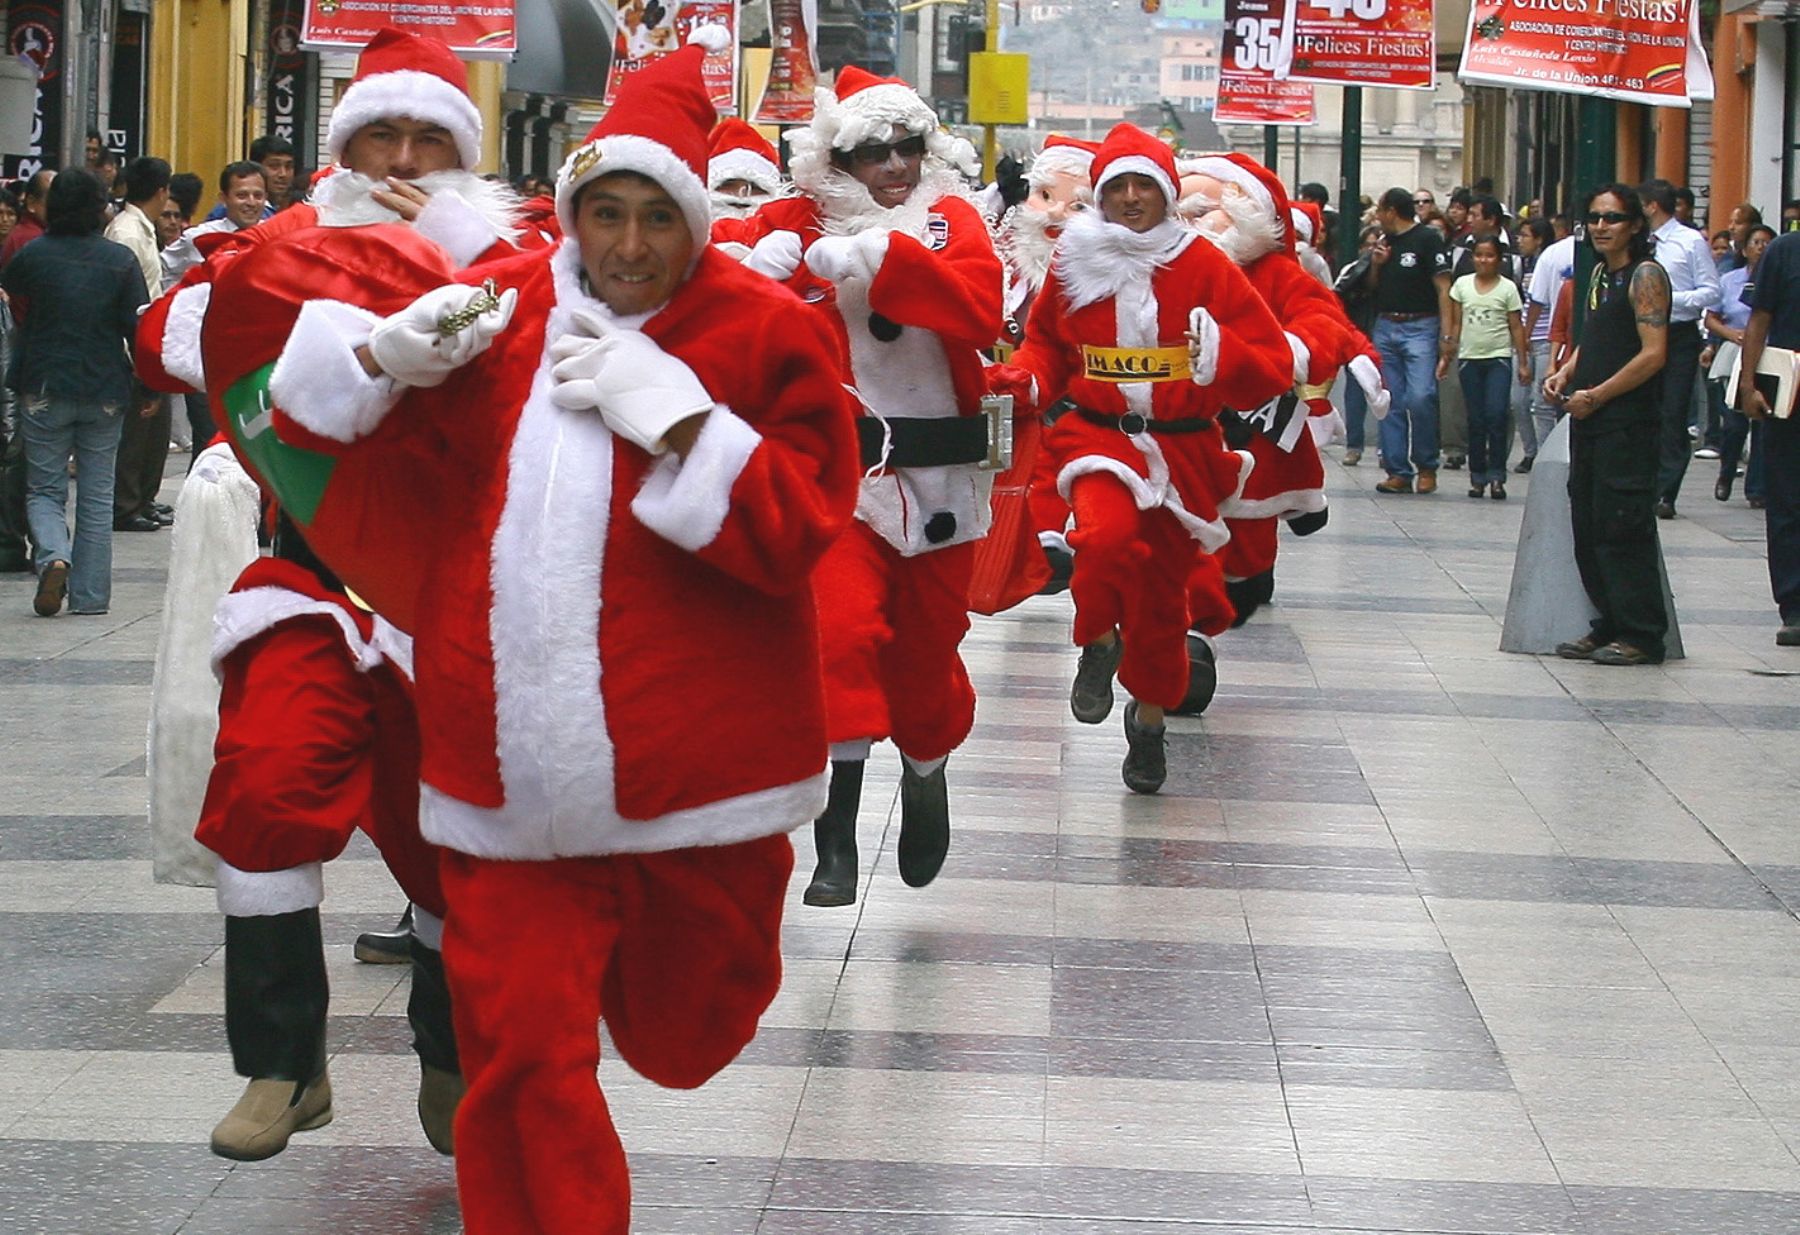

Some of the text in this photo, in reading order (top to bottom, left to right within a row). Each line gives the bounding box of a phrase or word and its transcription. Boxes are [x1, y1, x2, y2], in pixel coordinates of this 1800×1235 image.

[1235, 17, 1280, 71] 35
[1366, 37, 1430, 58] Fiestas!
[1471, 43, 1499, 54] Luis
[1532, 67, 1547, 79] de
[1550, 69, 1561, 80] la
